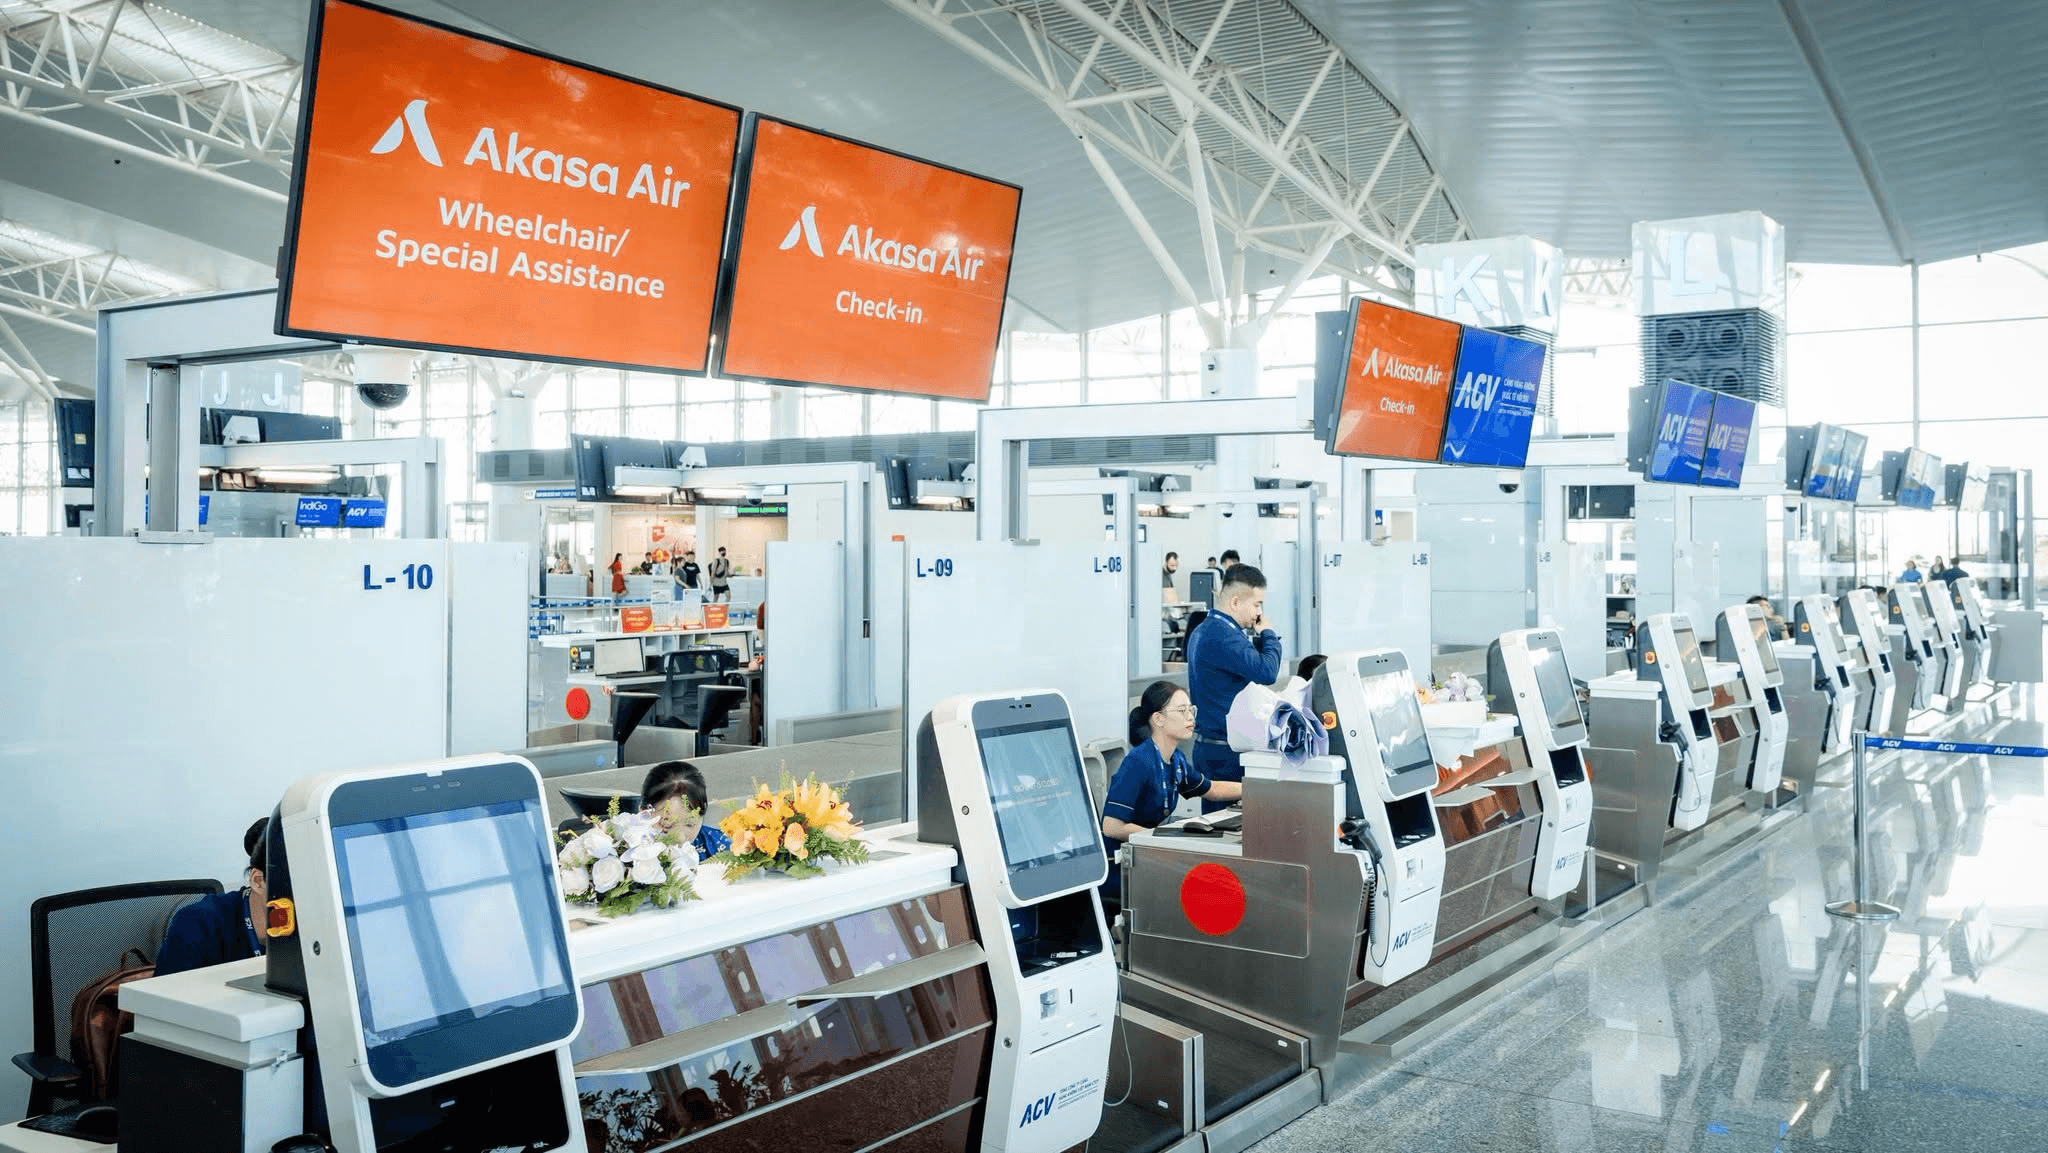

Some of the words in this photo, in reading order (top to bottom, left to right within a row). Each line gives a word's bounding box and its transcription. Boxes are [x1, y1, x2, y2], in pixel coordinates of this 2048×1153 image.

[464, 126, 618, 196] Akasa
[625, 165, 691, 209] Air
[439, 197, 631, 258] Wheelchair/
[376, 229, 498, 275] Special
[508, 252, 665, 299] Assistance
[837, 224, 938, 275] Akasa
[939, 244, 984, 282] Air
[835, 289, 923, 325] Check-in
[1383, 358, 1424, 383] Akasa
[1424, 364, 1443, 385] Air
[1380, 396, 1415, 415] Check-in
[1454, 371, 1502, 412] ACV
[1660, 413, 1688, 444] ACV
[364, 564, 433, 590] L-10
[916, 557, 954, 578] L-09
[1093, 556, 1122, 573] L-08
[1882, 739, 1901, 748] ACV
[1937, 743, 1957, 751] ACV
[1994, 747, 2014, 755] ACV
[1019, 1092, 1057, 1129] ACV
